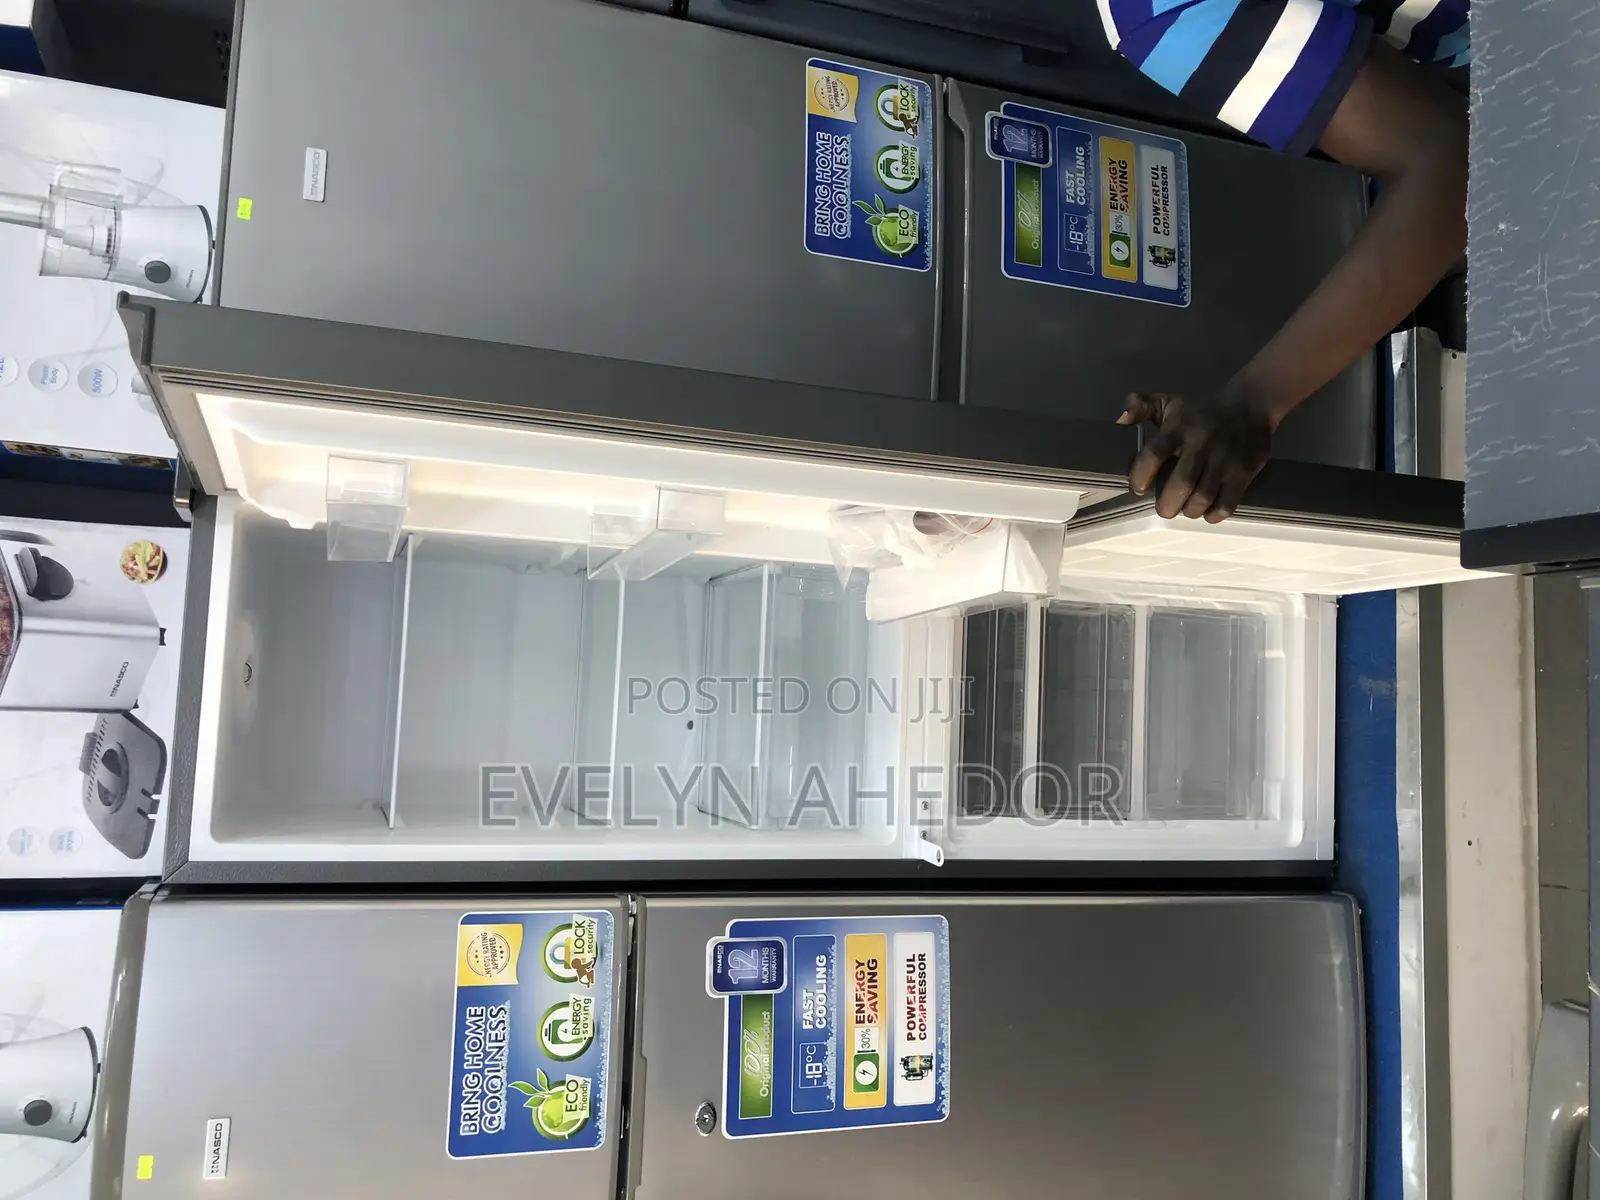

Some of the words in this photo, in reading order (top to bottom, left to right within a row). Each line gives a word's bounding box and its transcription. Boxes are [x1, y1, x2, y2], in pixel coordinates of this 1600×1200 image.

[900, 84, 910, 111] LOCK
[909, 86, 918, 112] security
[816, 131, 832, 183] HOME
[1002, 124, 1028, 153] 12
[901, 144, 910, 175] ENERGY
[1076, 146, 1086, 206] COOLING
[832, 134, 850, 239] COOLNESS
[1065, 169, 1076, 204] FAST
[1108, 157, 1118, 210] ENERGY
[1118, 159, 1129, 212] SAVING
[1151, 164, 1162, 234] POWERFUL
[1160, 165, 1170, 237] COMPRESSOR
[815, 186, 831, 237] BRING
[899, 208, 909, 237] ECO
[910, 212, 918, 238] friendly
[1032, 213, 1040, 250] Original
[1114, 214, 1124, 231] 30%
[92, 369, 102, 393] 500W
[112, 661, 129, 690] NASCO
[489, 938, 498, 970] APPROVED
[574, 920, 586, 954] LOCK
[586, 918, 596, 954] security
[728, 948, 758, 984] 12
[762, 946, 770, 984] MONTHS
[802, 988, 814, 1029] FAST
[816, 954, 828, 1028] COOLING
[856, 959, 866, 1024] ENERGY
[866, 958, 878, 1024] SAVING
[906, 954, 916, 1041] POWERFUL
[918, 952, 926, 1040] COMPRESSOR
[571, 996, 582, 1036] ENERGY
[582, 998, 592, 1034] saving
[761, 1010, 771, 1050] Product
[464, 1006, 486, 1068] HOME
[744, 1028, 762, 1076] 100%
[860, 1028, 870, 1048] 30%
[483, 1005, 507, 1134] COOLNESS
[761, 1054, 772, 1097] Original
[806, 1044, 822, 1086] -18°C
[460, 1072, 481, 1136] BRING
[565, 1079, 578, 1113] ECO
[579, 1079, 590, 1111] friendly
[212, 1122, 222, 1164] NASCO
